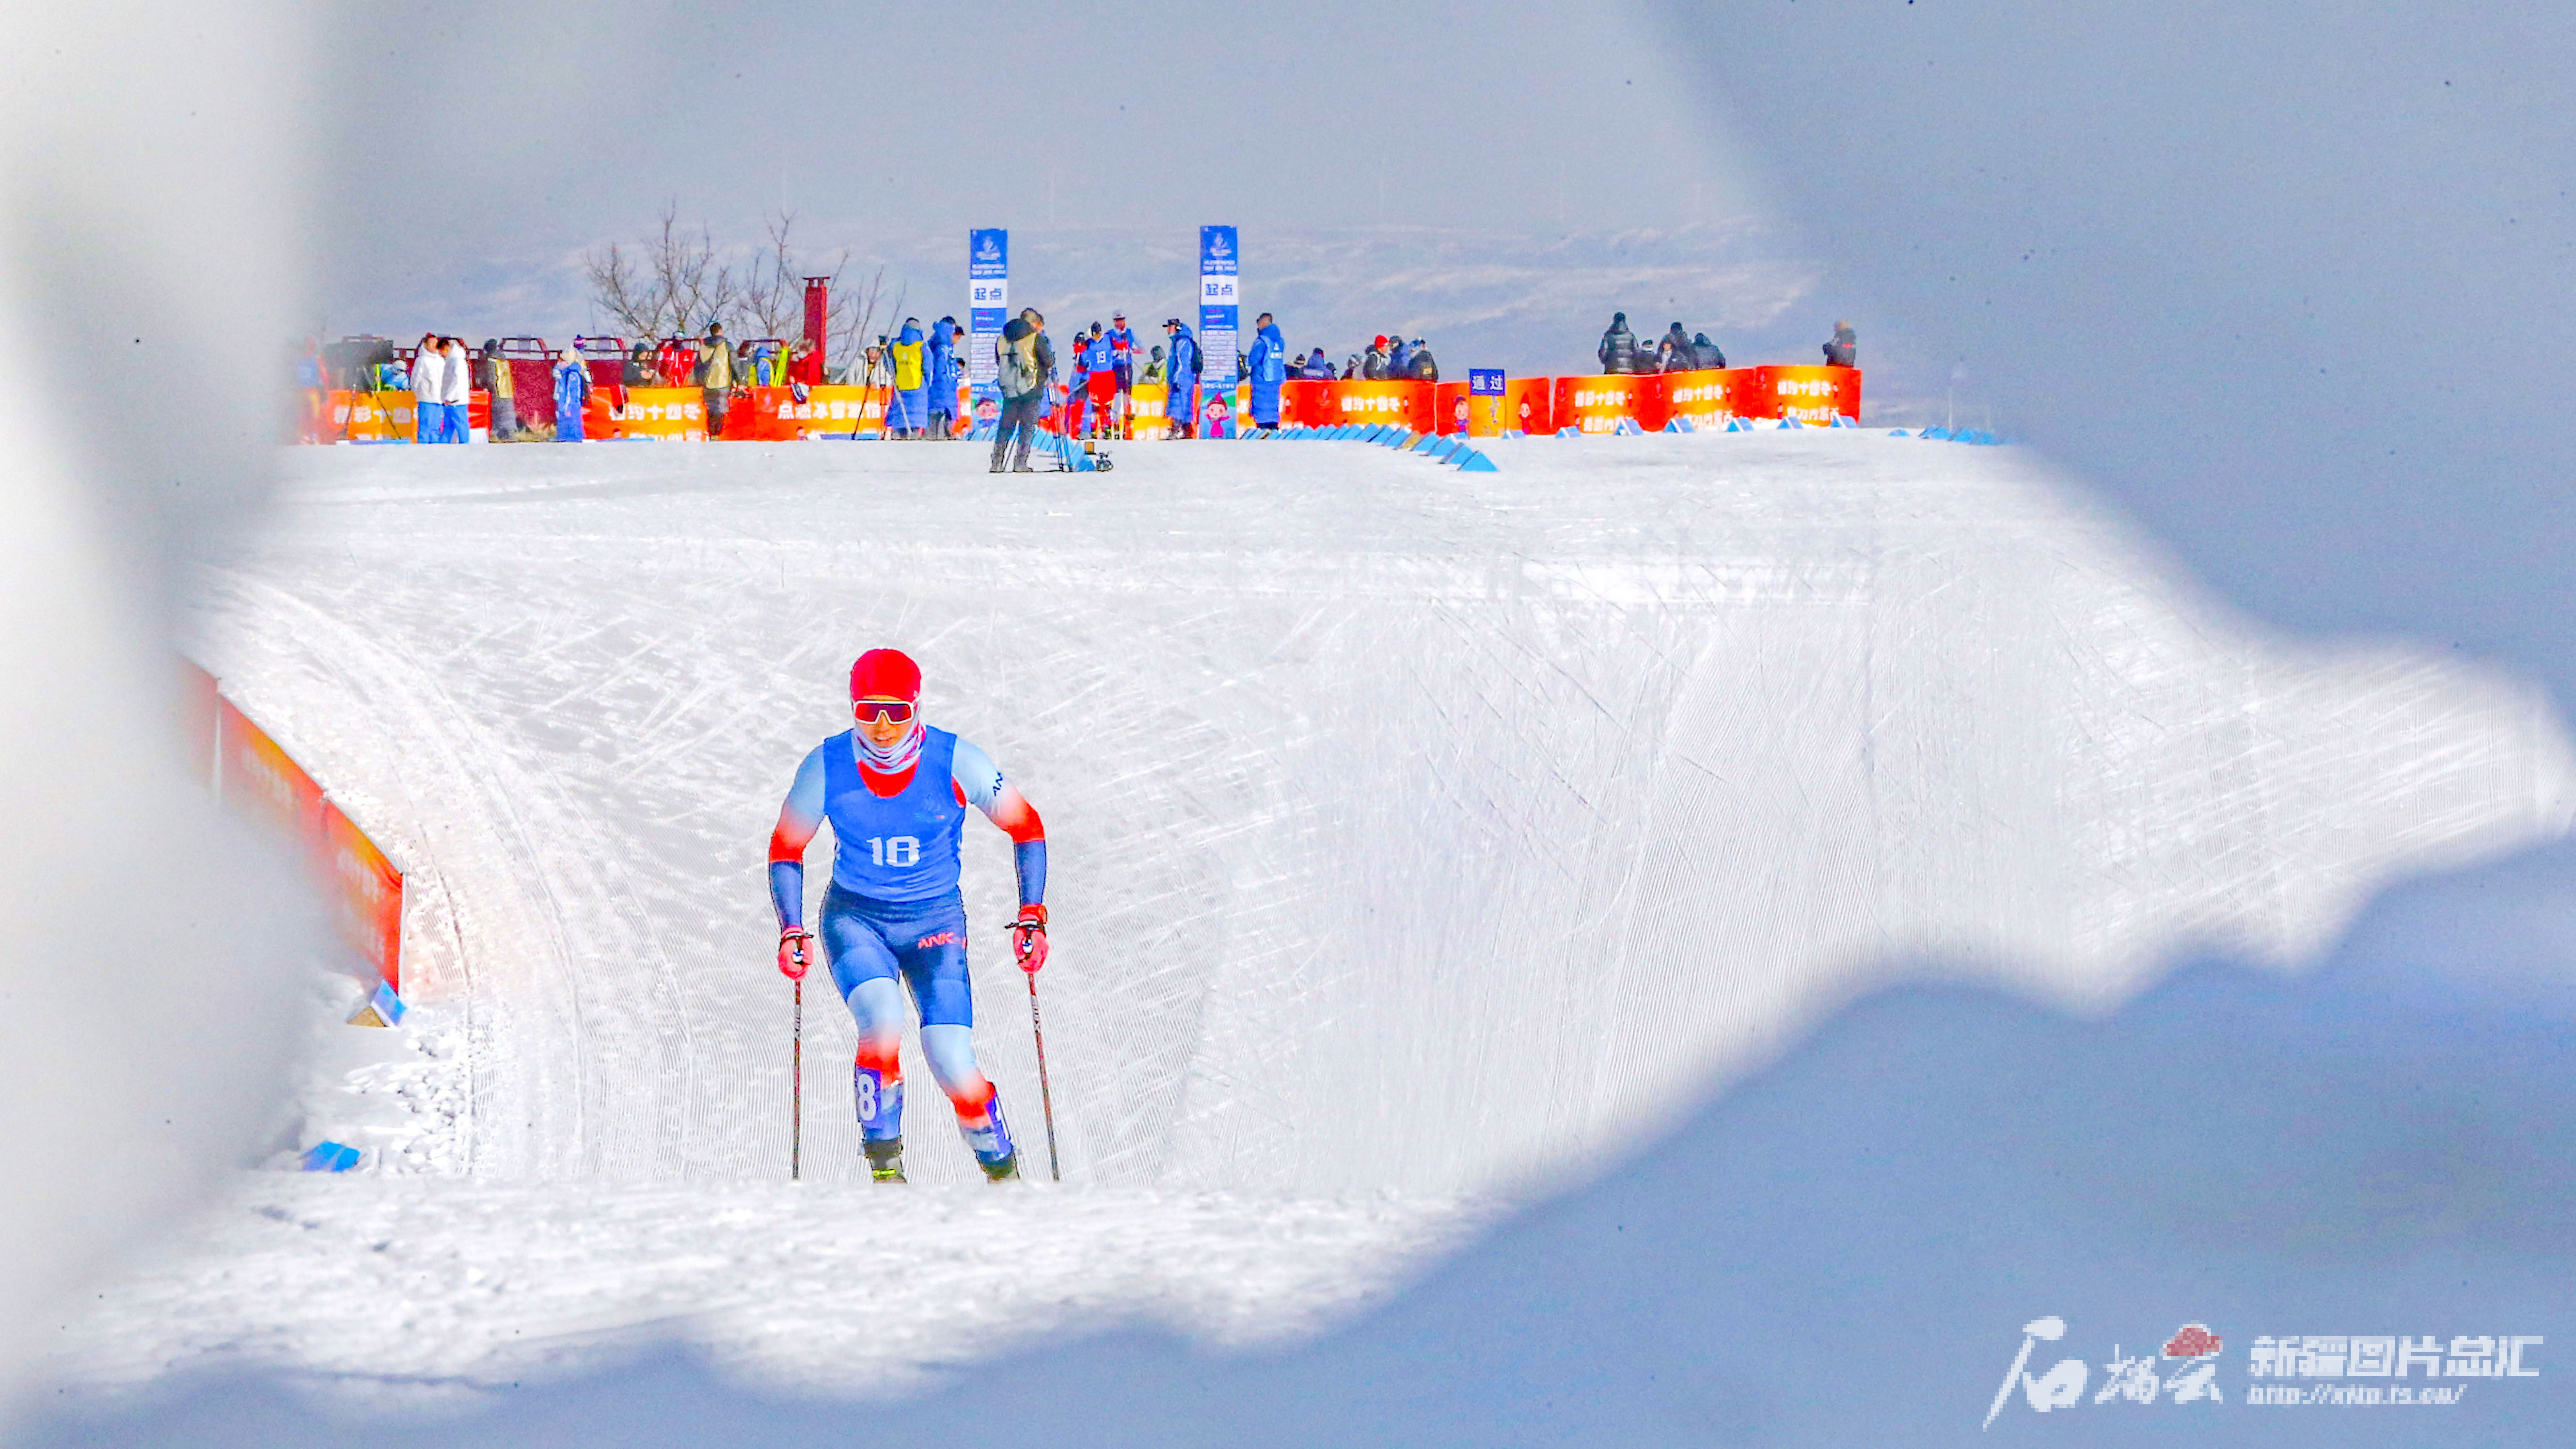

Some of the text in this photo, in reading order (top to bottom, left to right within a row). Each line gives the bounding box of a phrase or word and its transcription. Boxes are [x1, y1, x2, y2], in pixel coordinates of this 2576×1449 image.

[974, 288, 1002, 300] 起点
[1096, 350, 1106, 364] 19
[1472, 375, 1503, 390] 通过
[866, 835, 920, 867] 18
